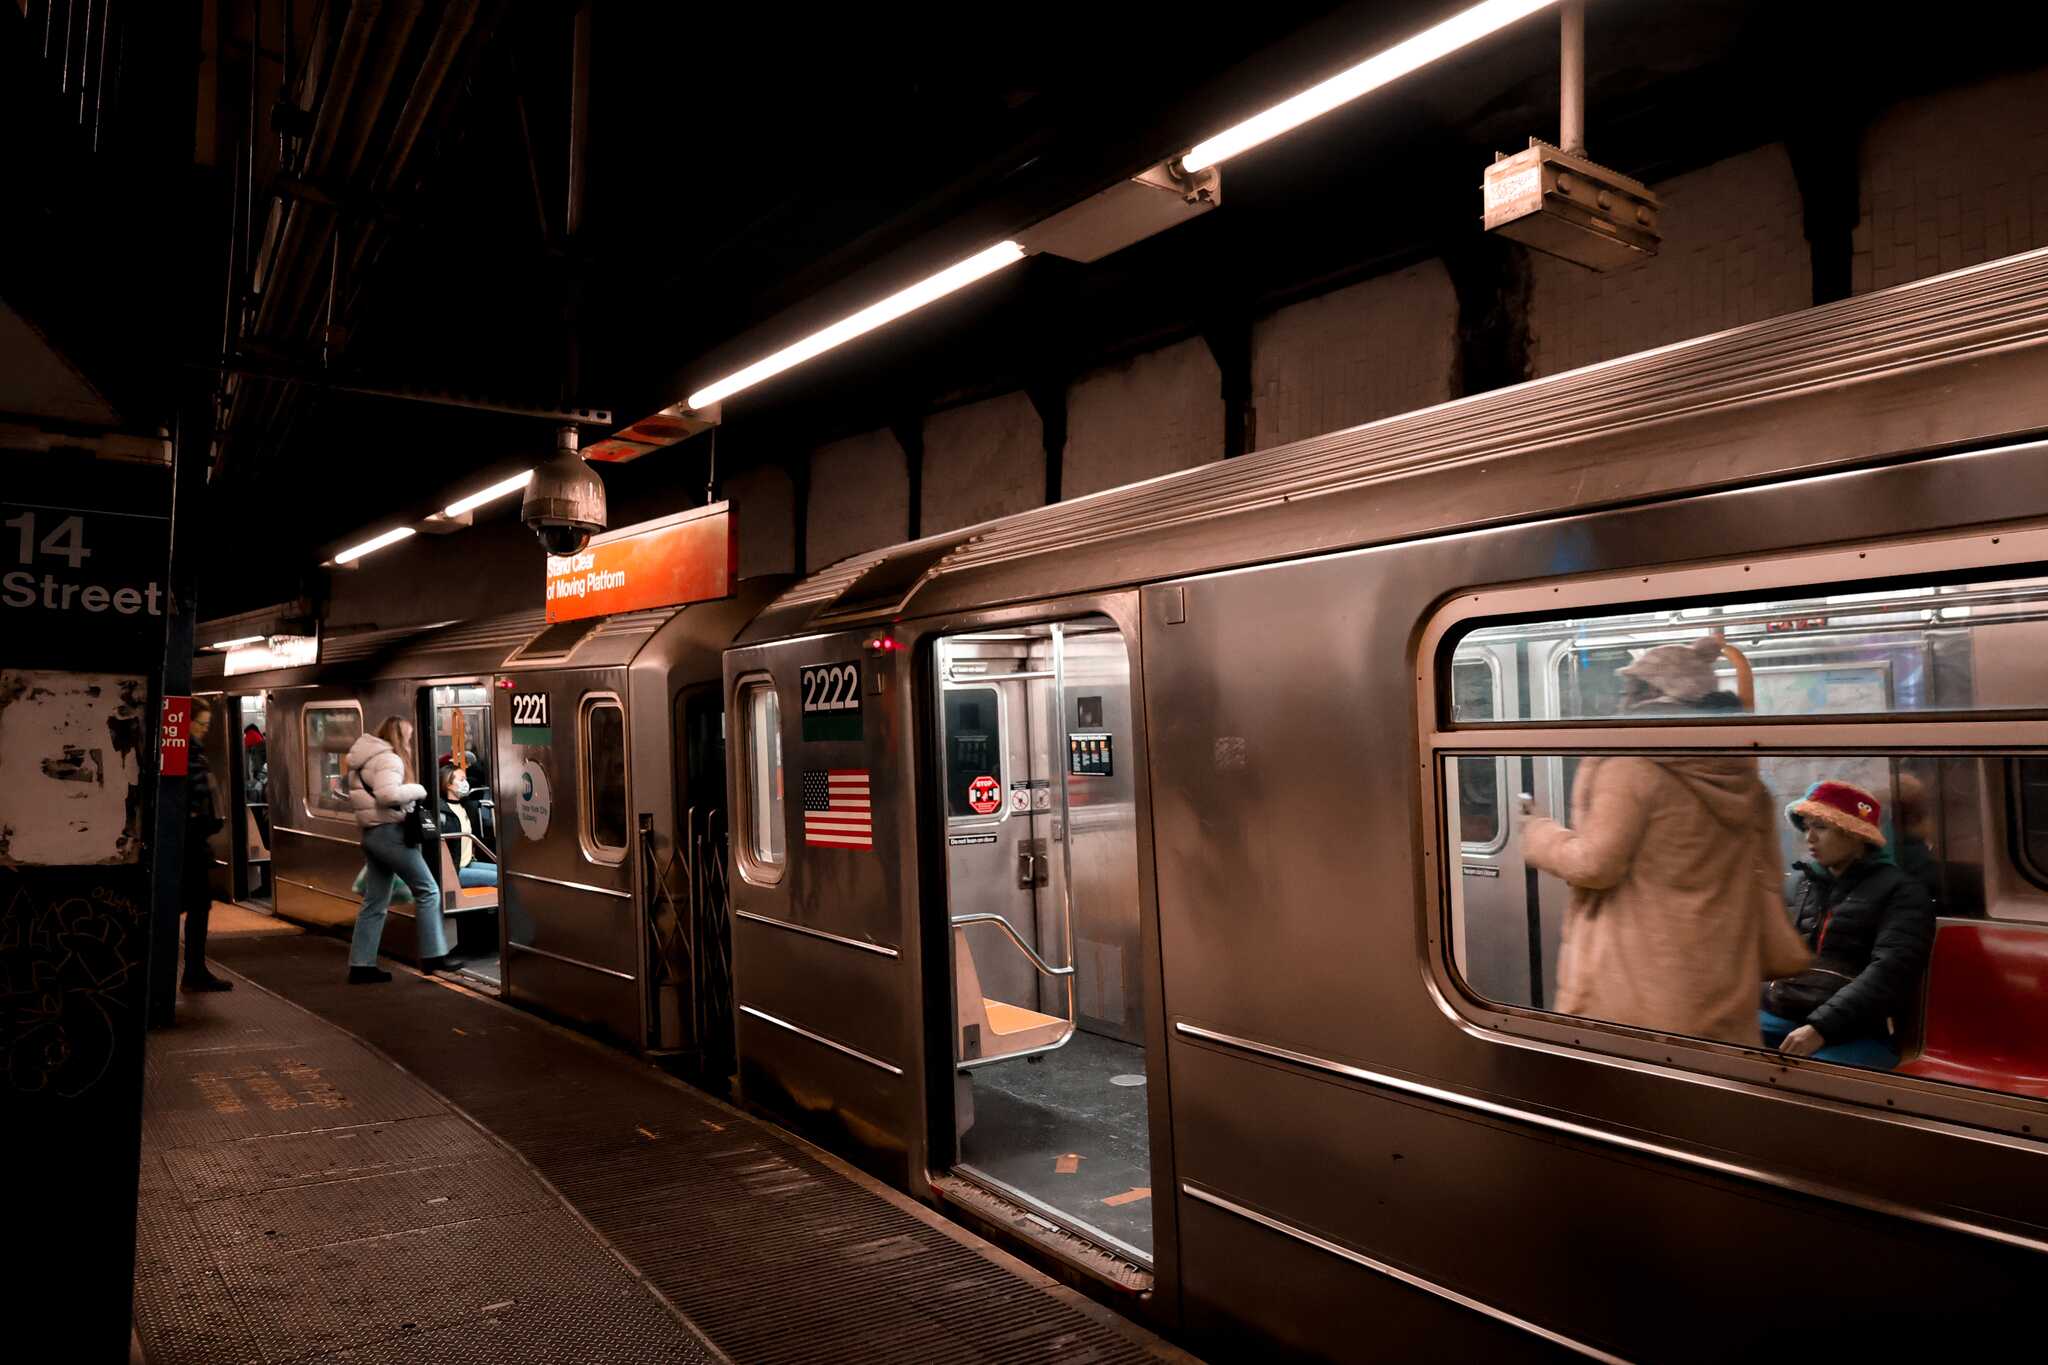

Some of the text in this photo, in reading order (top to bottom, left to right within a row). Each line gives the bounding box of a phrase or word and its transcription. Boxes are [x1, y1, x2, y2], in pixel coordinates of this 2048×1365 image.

[5, 511, 92, 568] 14
[2, 571, 162, 616] Street
[547, 569, 625, 600] of Moving Platform
[803, 664, 859, 712] 2222
[168, 711, 184, 723] of
[513, 694, 547, 724] 2221
